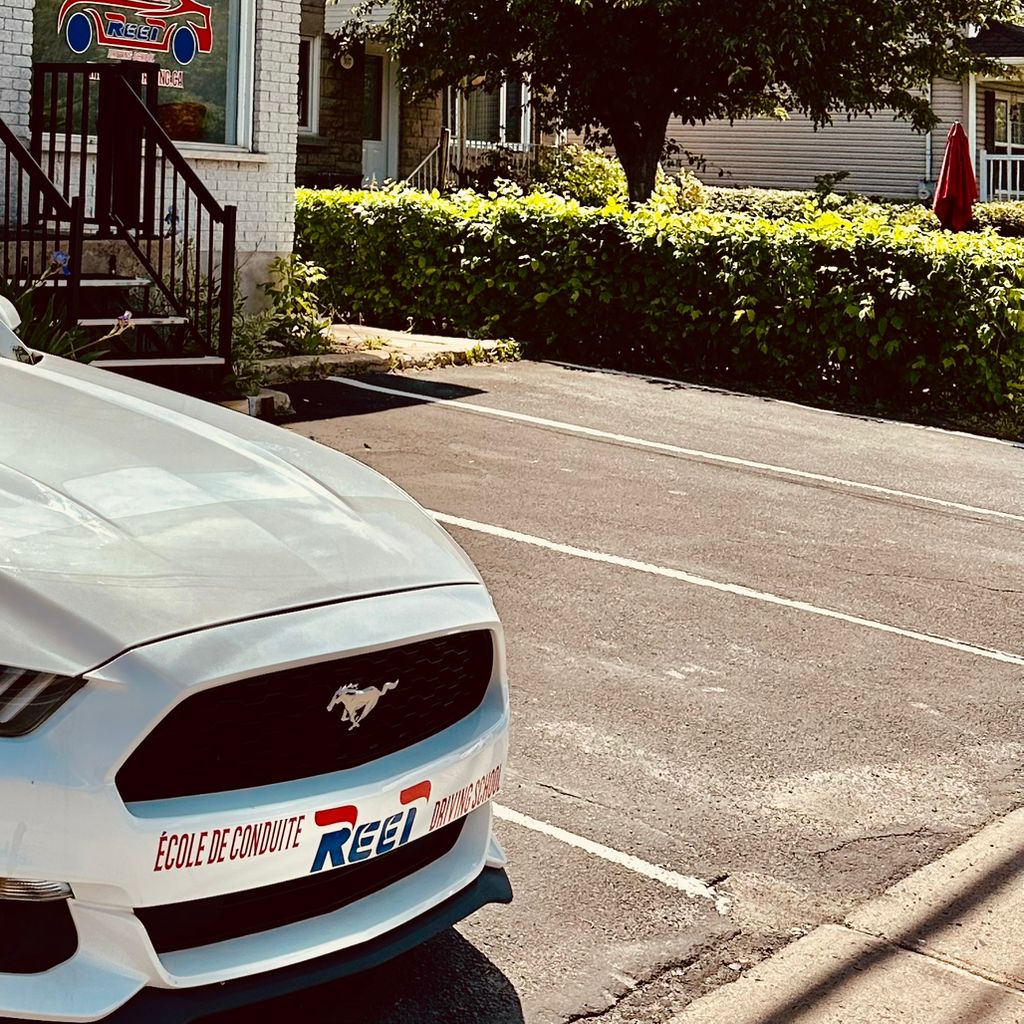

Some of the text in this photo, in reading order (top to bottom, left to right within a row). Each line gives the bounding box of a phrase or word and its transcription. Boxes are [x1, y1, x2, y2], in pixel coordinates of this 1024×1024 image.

[104, 11, 167, 42] REET
[309, 779, 431, 874] REET
[429, 763, 503, 831] DRIVING SCHOOL
[153, 814, 306, 872] ÉCOLE DE CONDUITE
